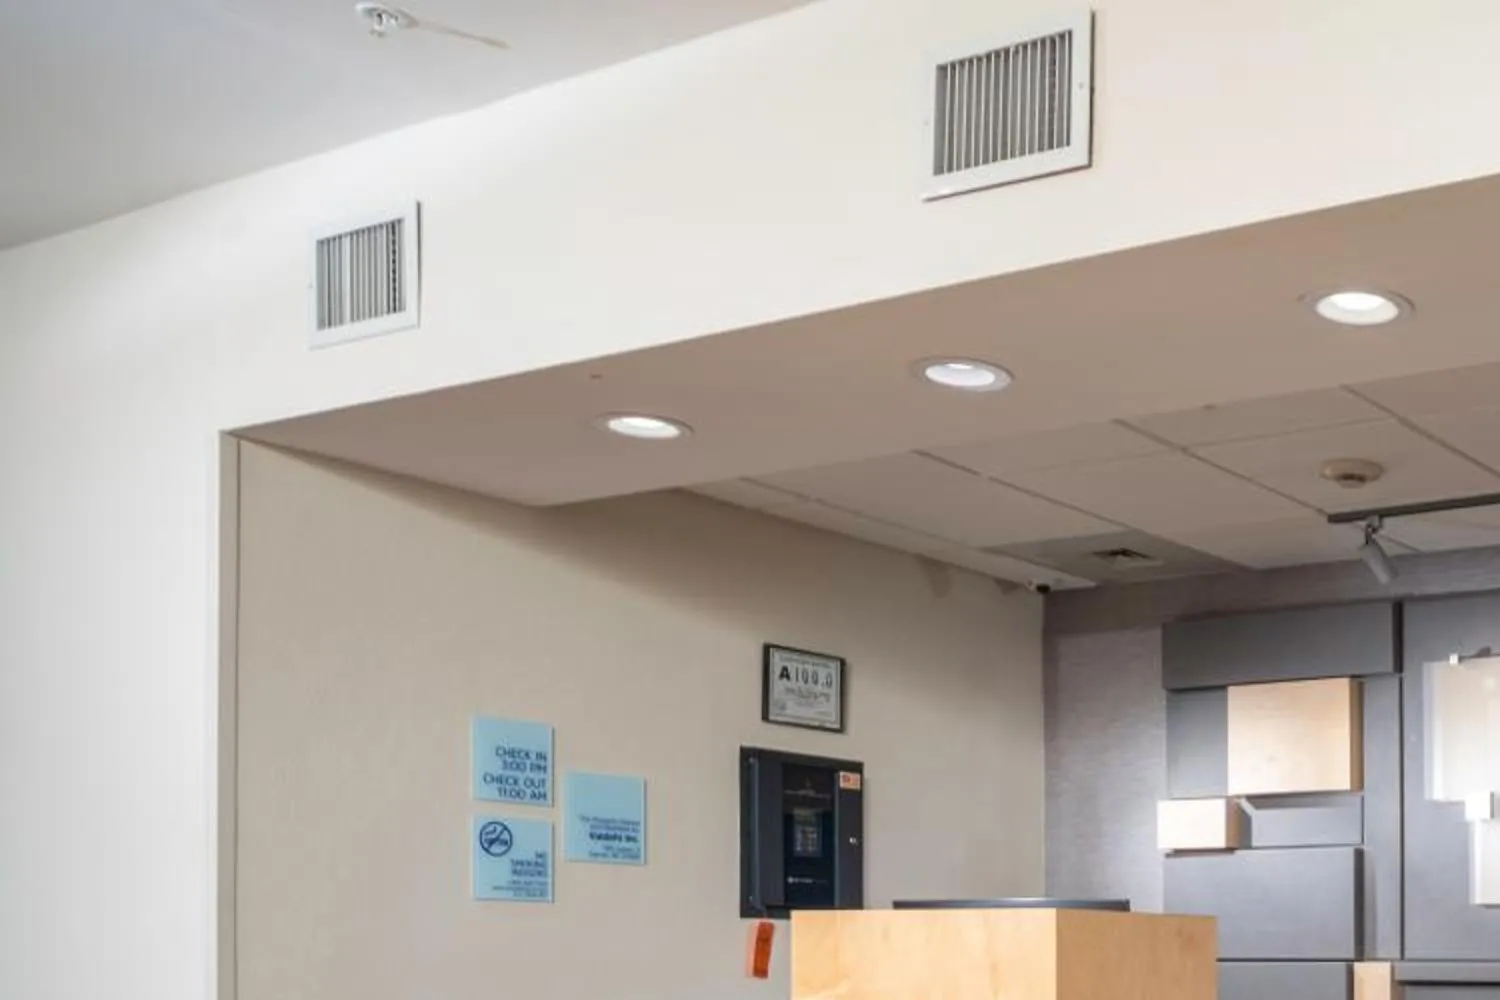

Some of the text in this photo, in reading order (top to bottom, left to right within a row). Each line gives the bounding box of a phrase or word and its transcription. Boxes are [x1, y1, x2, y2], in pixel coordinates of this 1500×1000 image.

[779, 665, 791, 681] A
[495, 745, 531, 761] CHECK
[483, 772, 547, 790] CHECK OUT
[529, 789, 547, 802] AM
